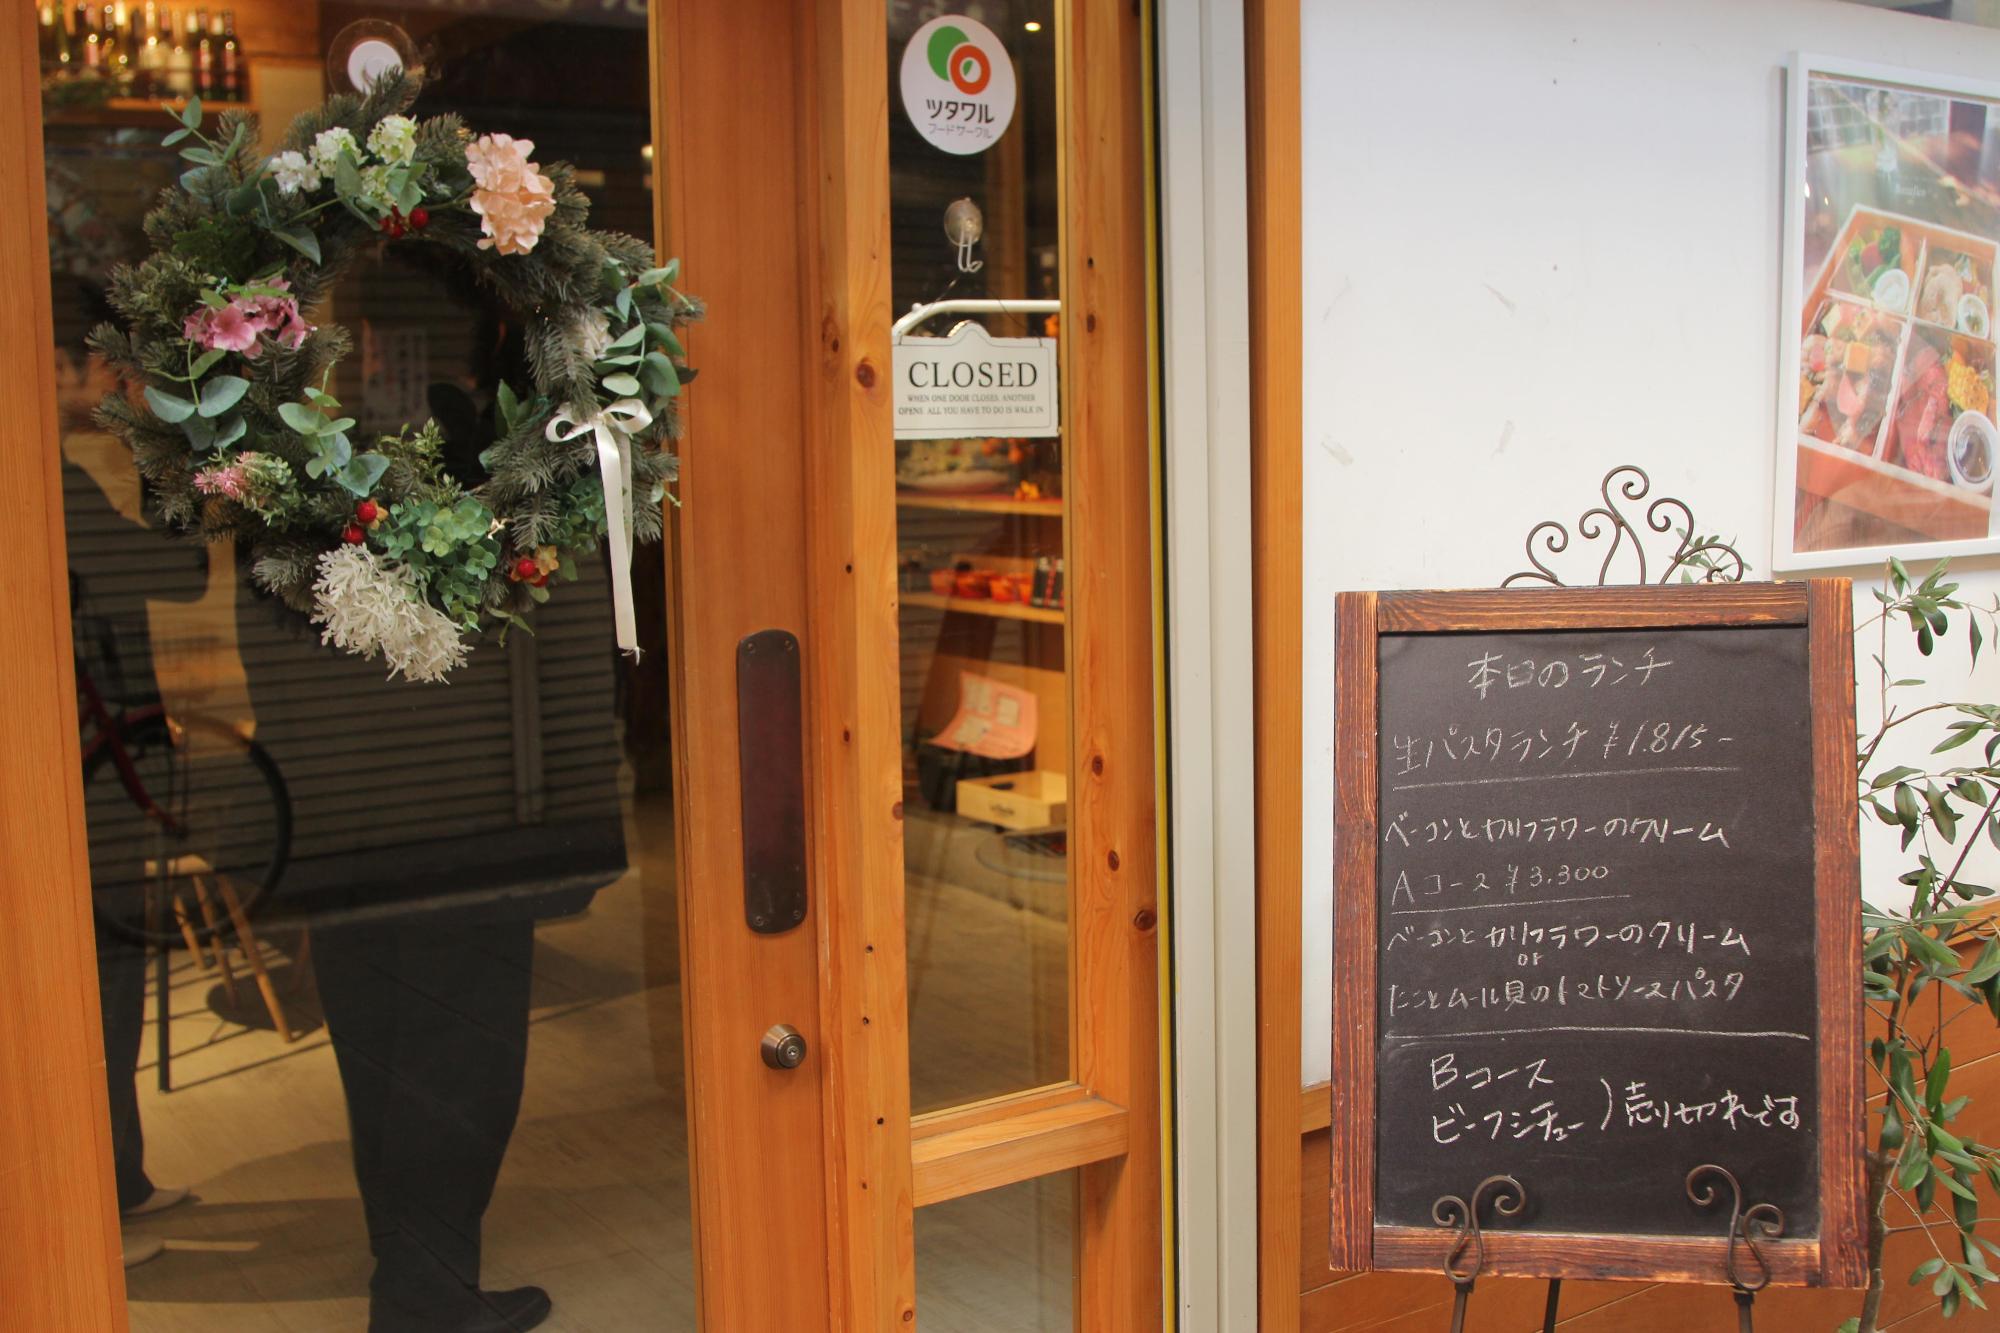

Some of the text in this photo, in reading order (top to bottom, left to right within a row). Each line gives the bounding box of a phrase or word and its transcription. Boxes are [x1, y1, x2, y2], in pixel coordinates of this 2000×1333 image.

[926, 98, 995, 124] ツタワル
[908, 361, 1037, 388] CLOSED
[927, 406, 942, 415] ALL
[943, 406, 959, 415] YOU
[960, 406, 980, 414] HAVE
[981, 406, 992, 414] TO
[993, 406, 1005, 414] DO
[1005, 406, 1013, 414] IS
[1014, 405, 1034, 413] WALK
[931, 394, 947, 403] ONE
[949, 394, 969, 402] DOOR
[1468, 646, 1673, 700] 本日のランチ
[1393, 721, 1588, 775] 生パスタランチ
[1433, 1081, 1800, 1144] ビーフシチュー 売り切れです
